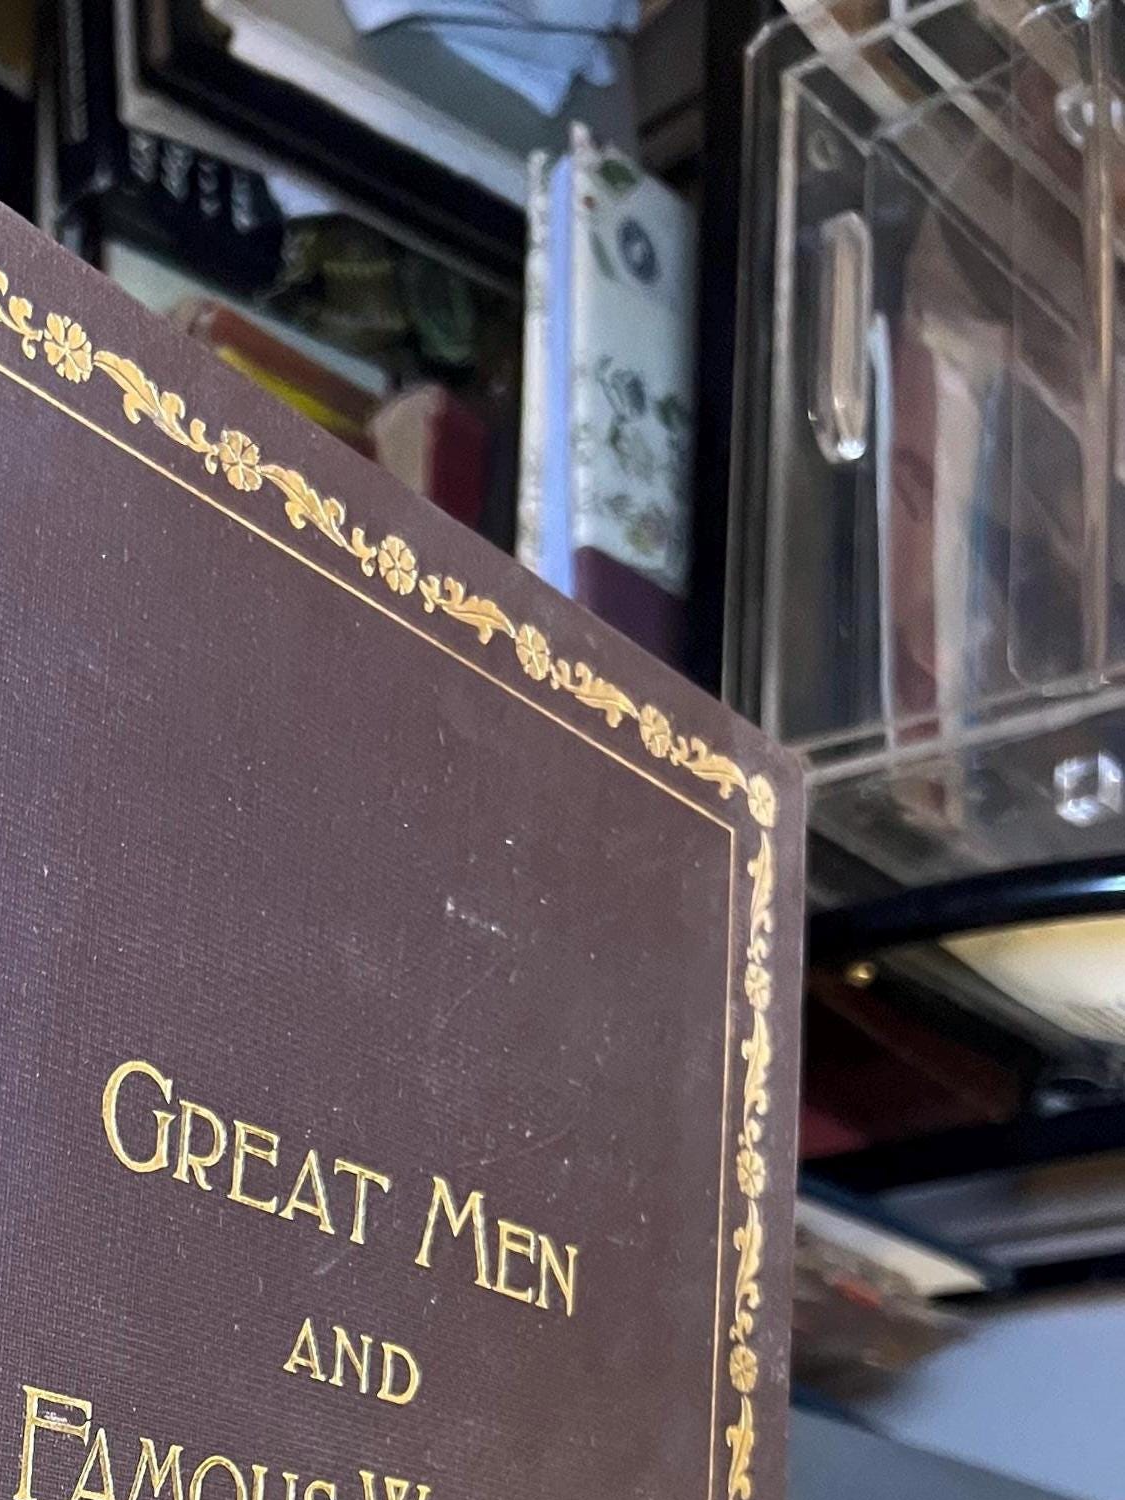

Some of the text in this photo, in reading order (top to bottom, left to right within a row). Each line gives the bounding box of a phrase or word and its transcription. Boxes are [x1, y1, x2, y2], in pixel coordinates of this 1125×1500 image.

[102, 1060, 578, 1317] GREAT MEN
[283, 1317, 423, 1404] AND
